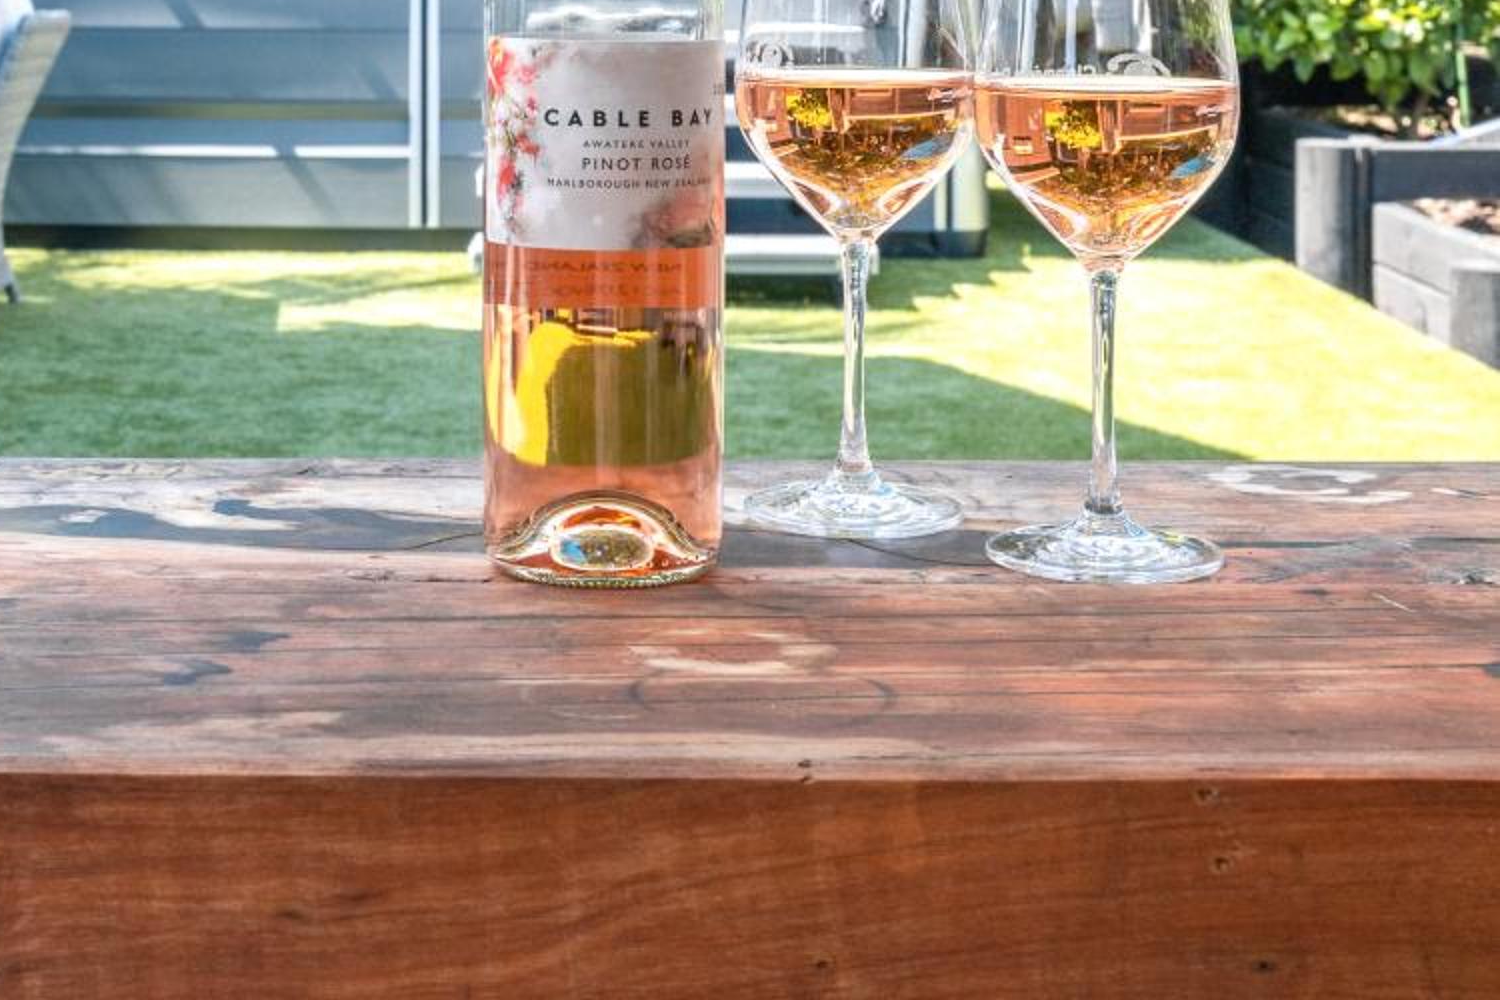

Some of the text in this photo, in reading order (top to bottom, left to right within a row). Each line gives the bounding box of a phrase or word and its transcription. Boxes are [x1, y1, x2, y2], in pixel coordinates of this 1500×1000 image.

[544, 107, 713, 128] CABLE BAY
[583, 139, 690, 149] AWATERE VALLEY
[581, 154, 692, 171] PINOT ROSÉ
[547, 177, 640, 190] MARLBOROUGH
[645, 179, 670, 189] NEW
